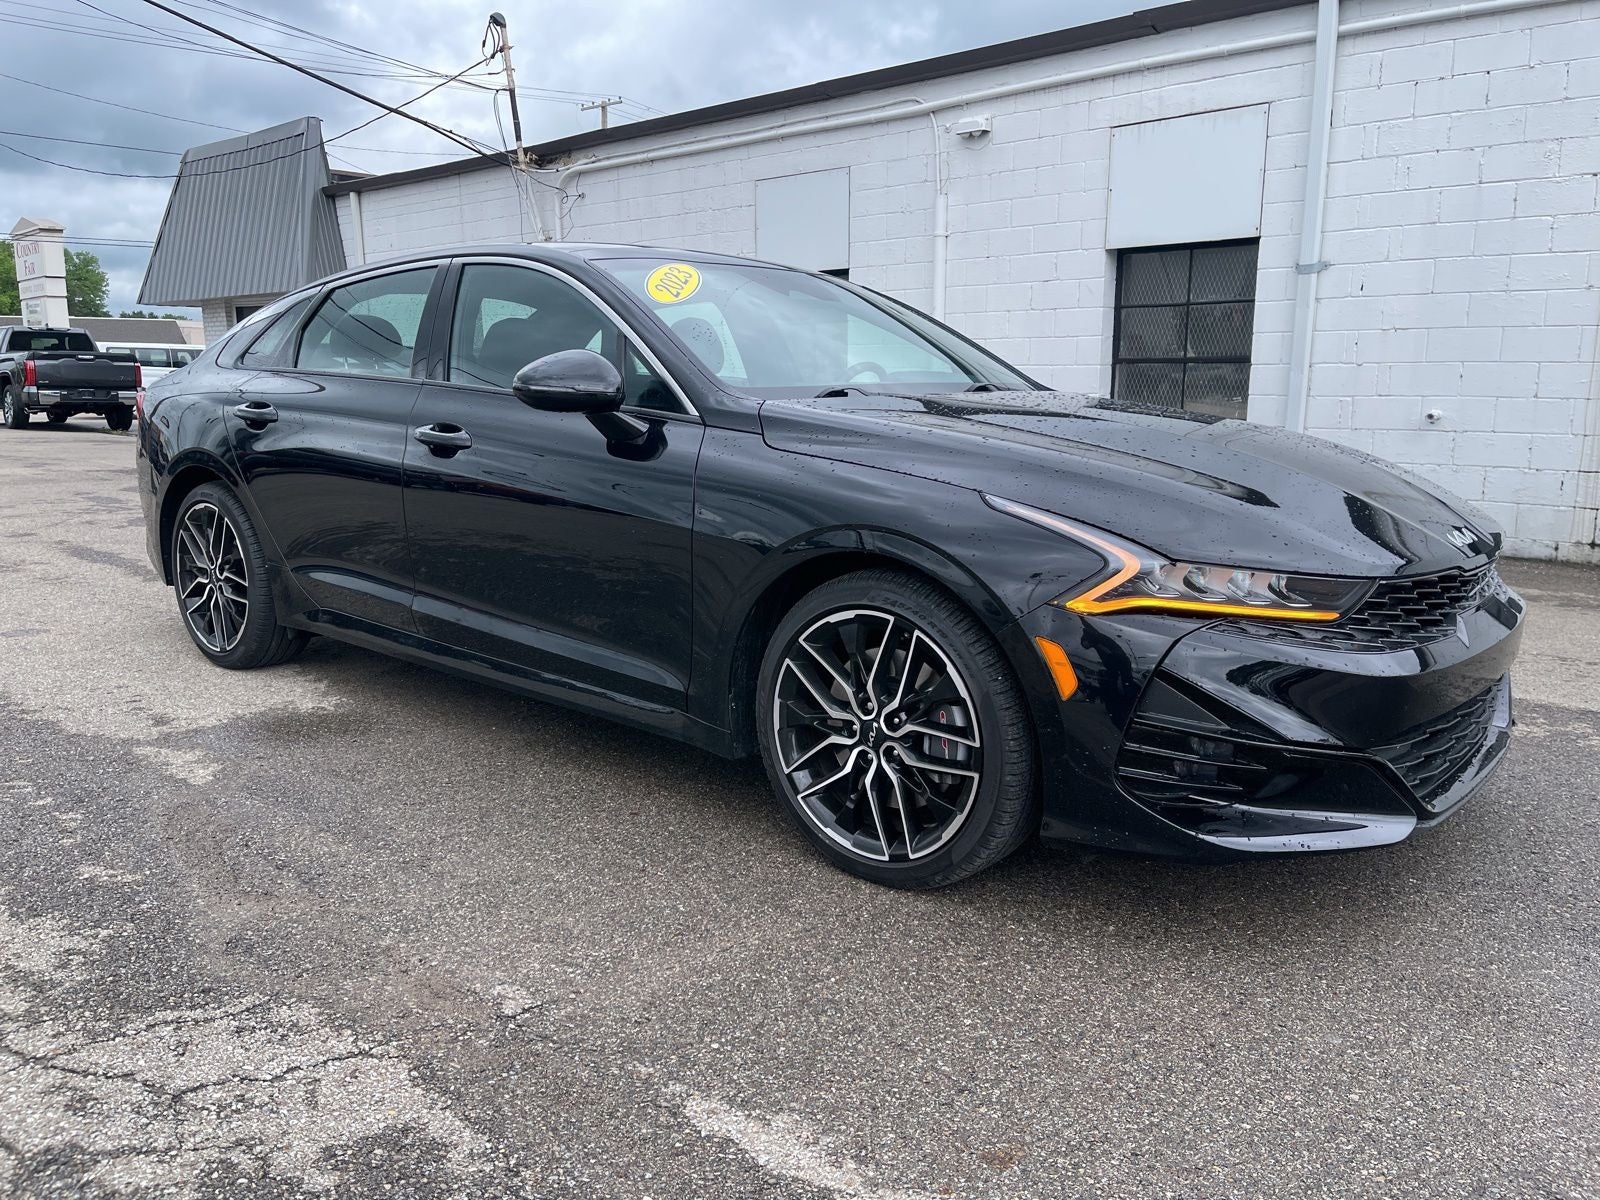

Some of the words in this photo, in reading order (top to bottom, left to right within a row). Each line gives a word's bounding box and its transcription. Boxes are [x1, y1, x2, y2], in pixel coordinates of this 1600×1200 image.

[16, 242, 40, 259] COUNTRY
[24, 260, 36, 276] FAIR
[655, 267, 692, 298] 2023
